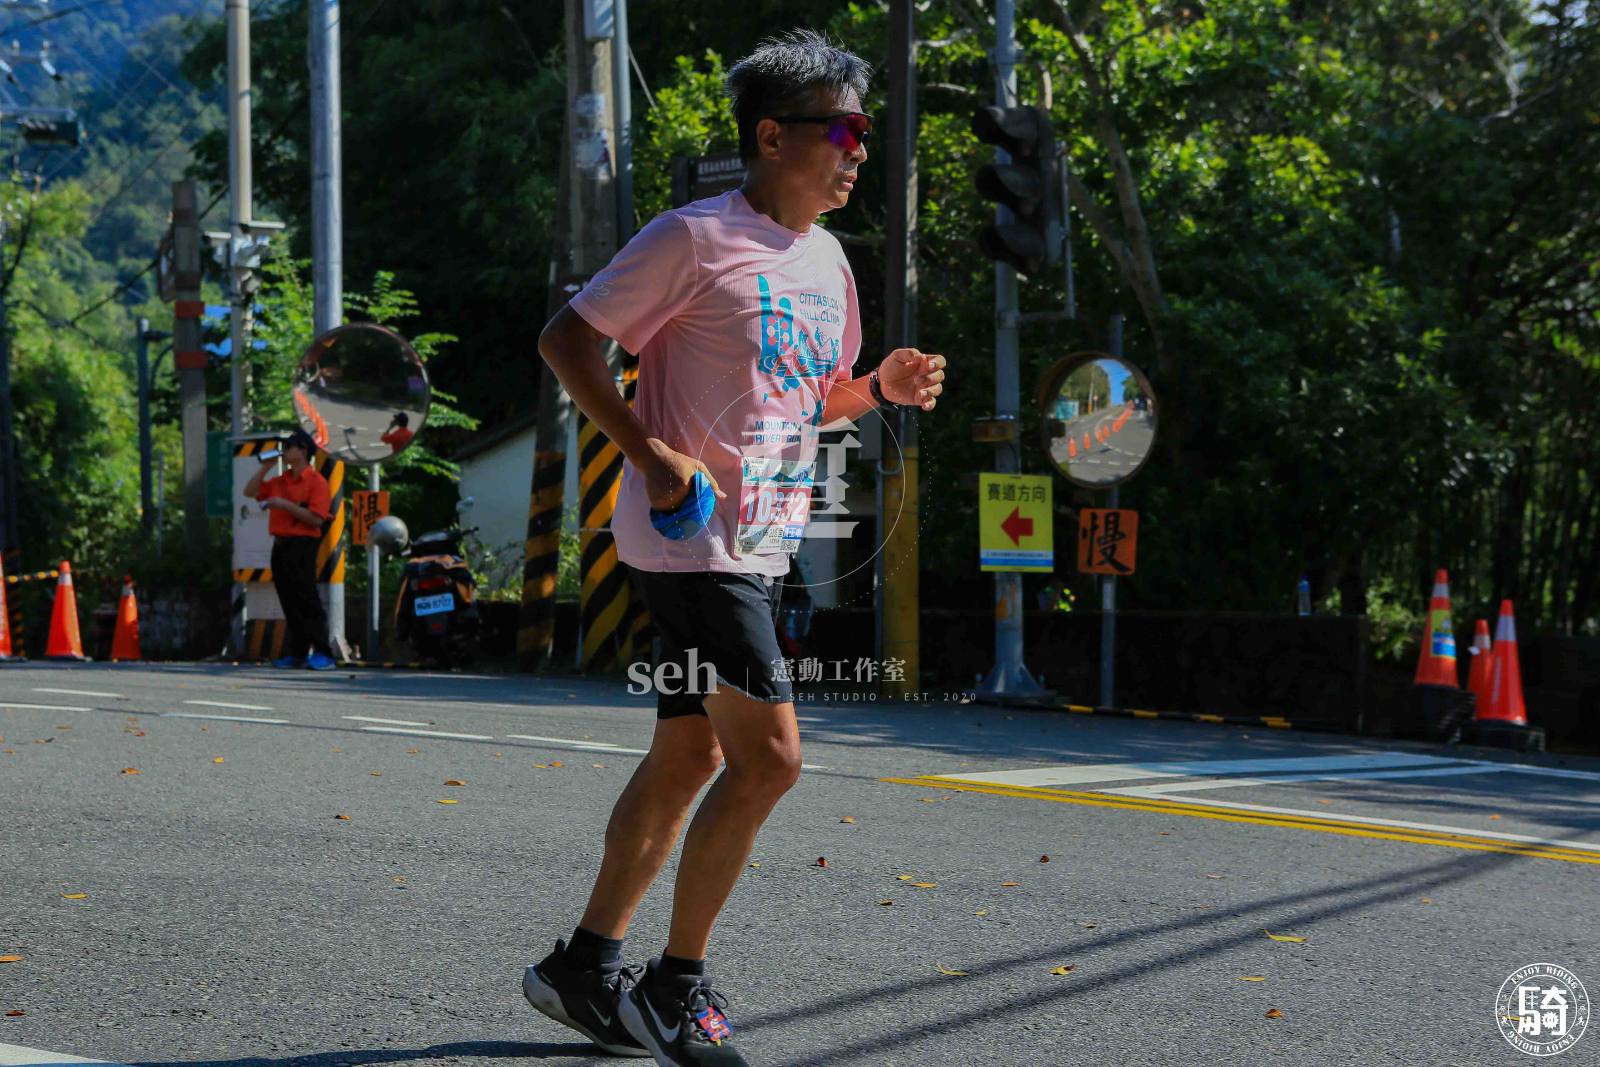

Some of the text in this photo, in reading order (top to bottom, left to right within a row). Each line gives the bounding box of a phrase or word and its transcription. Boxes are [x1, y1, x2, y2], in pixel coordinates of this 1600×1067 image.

[755, 434, 781, 443] RIVER
[988, 483, 1046, 503] 賽道方向
[1082, 511, 1132, 572] 慢
